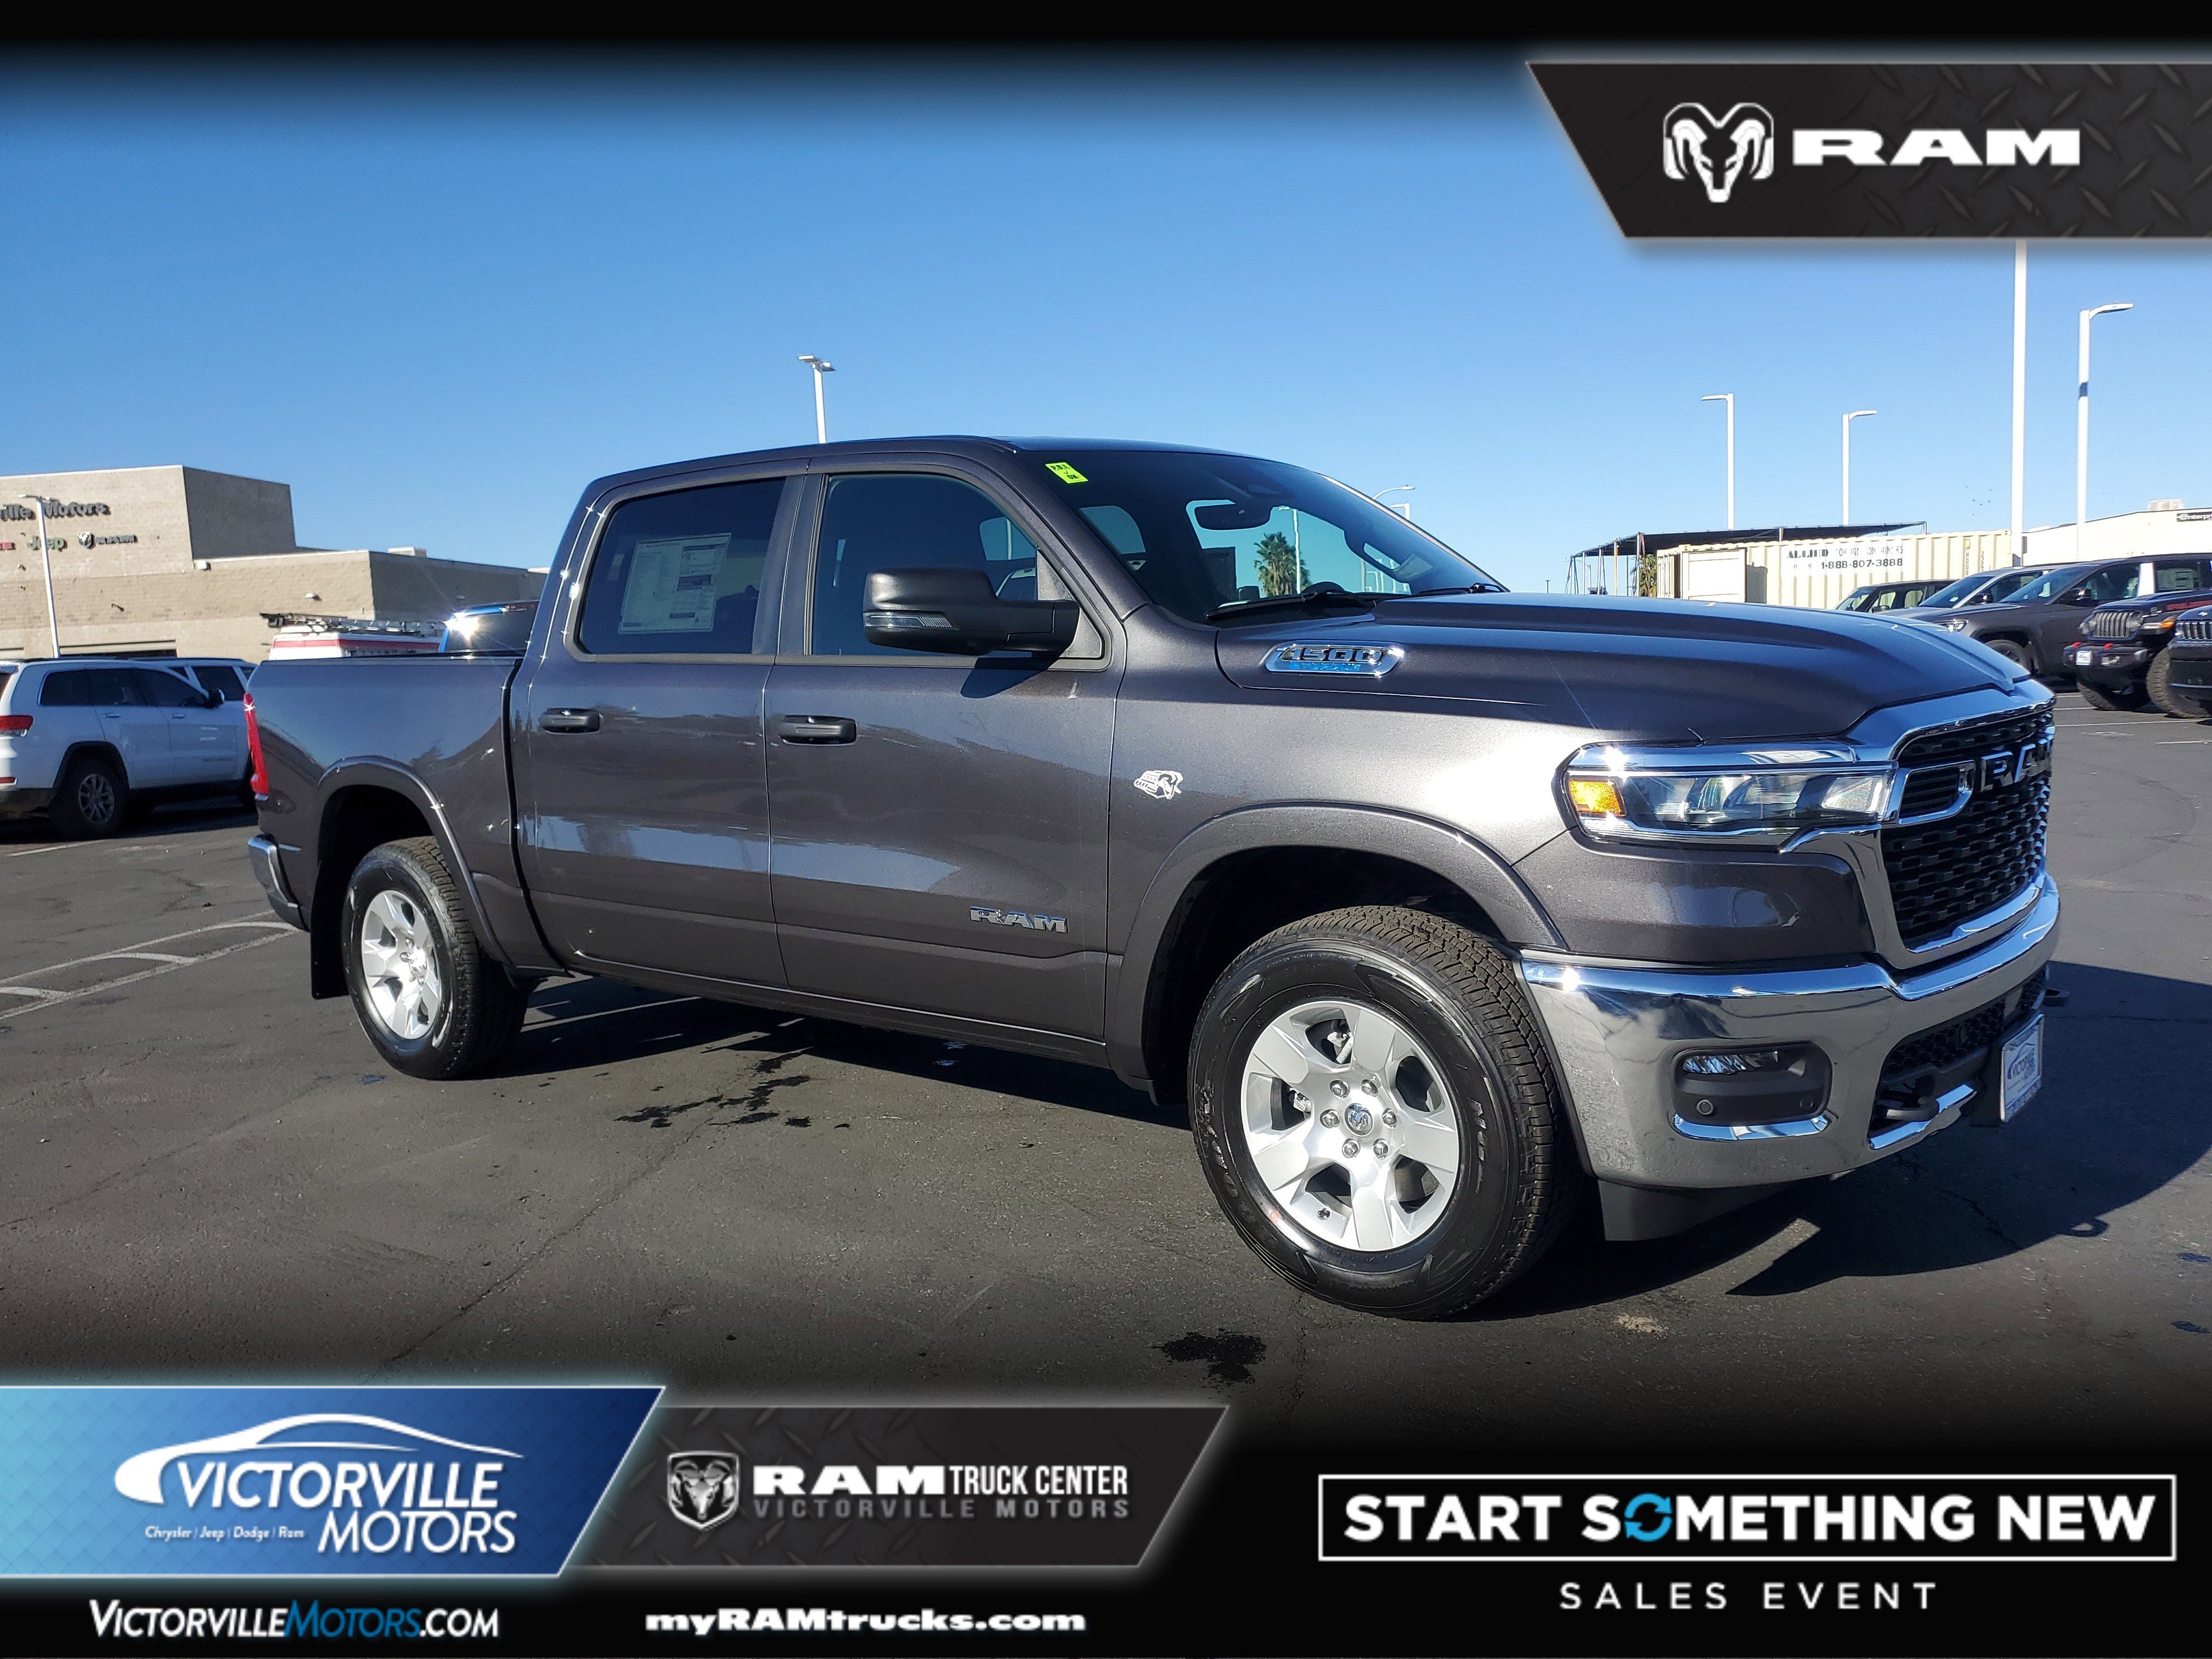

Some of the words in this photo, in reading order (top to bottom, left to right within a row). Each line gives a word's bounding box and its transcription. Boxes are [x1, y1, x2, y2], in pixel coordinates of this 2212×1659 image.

[0, 503, 34, 520] ille
[1787, 549, 1829, 558] ALLIED
[1821, 558, 1903, 569] 1-888-807-3888
[1288, 647, 1383, 663] 1500
[1980, 739, 2052, 792] RA
[969, 905, 1068, 933] RAM
